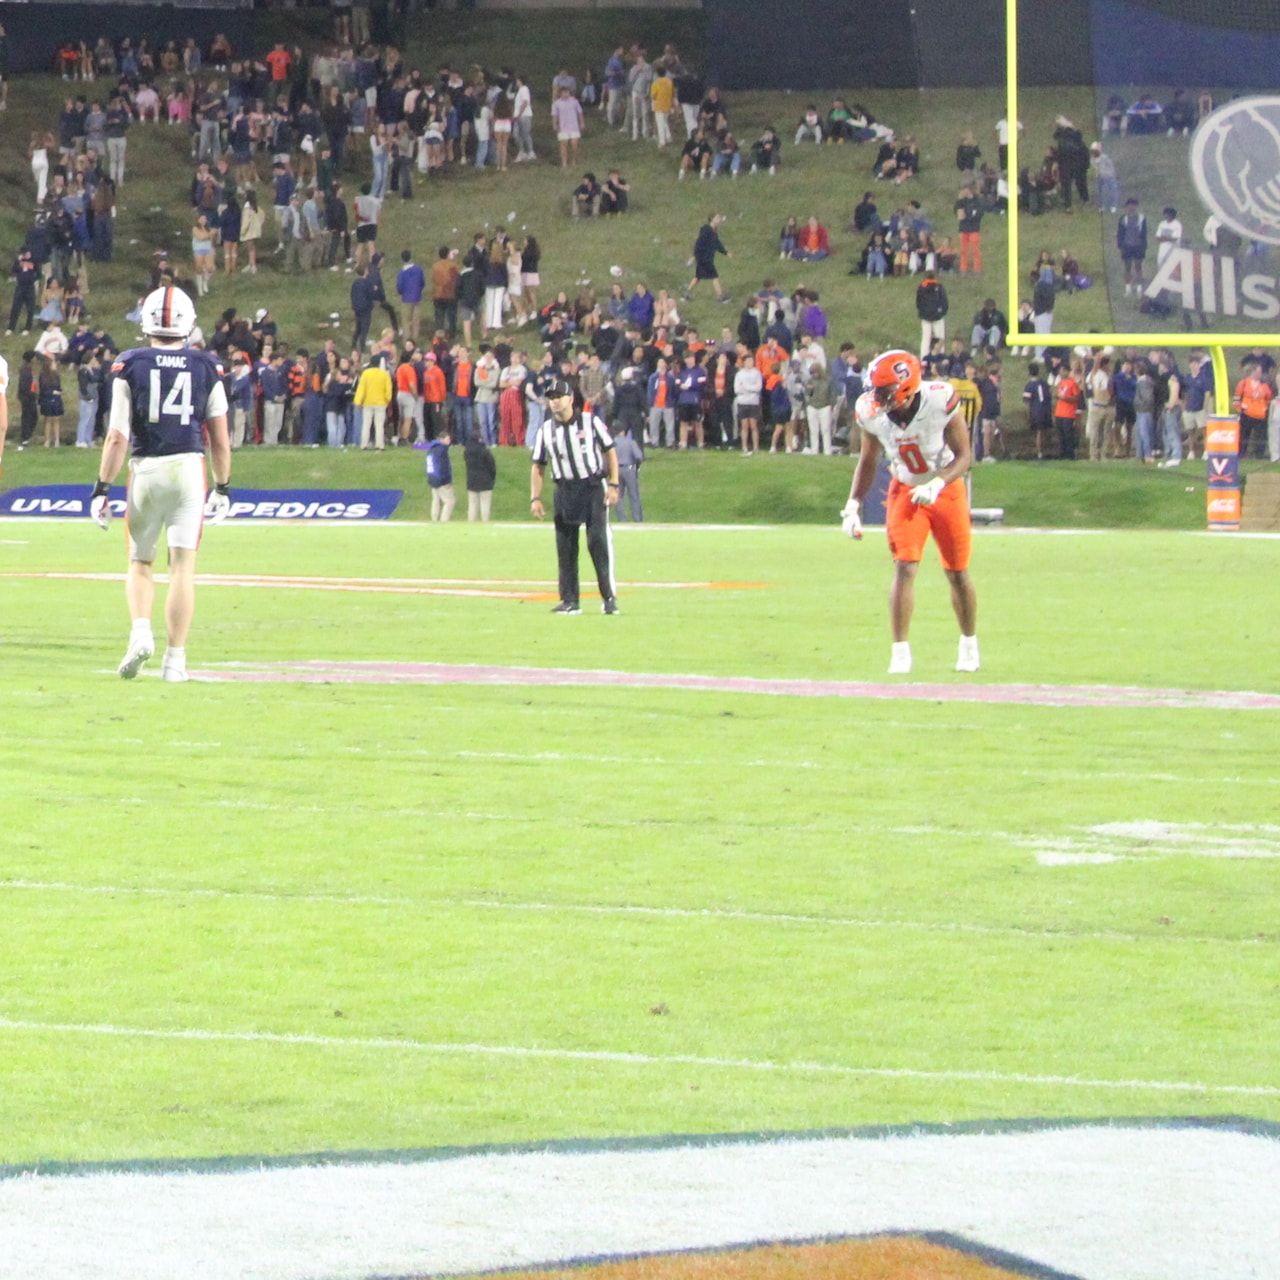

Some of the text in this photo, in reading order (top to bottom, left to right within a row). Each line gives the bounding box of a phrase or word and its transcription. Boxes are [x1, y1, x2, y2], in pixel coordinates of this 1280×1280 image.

[155, 355, 188, 370] CAMAC
[148, 368, 196, 426] 14
[1208, 429, 1236, 444] ACC
[899, 443, 929, 475] 0
[10, 498, 372, 519] UVA OPEDICS
[1208, 498, 1236, 513] ACC
